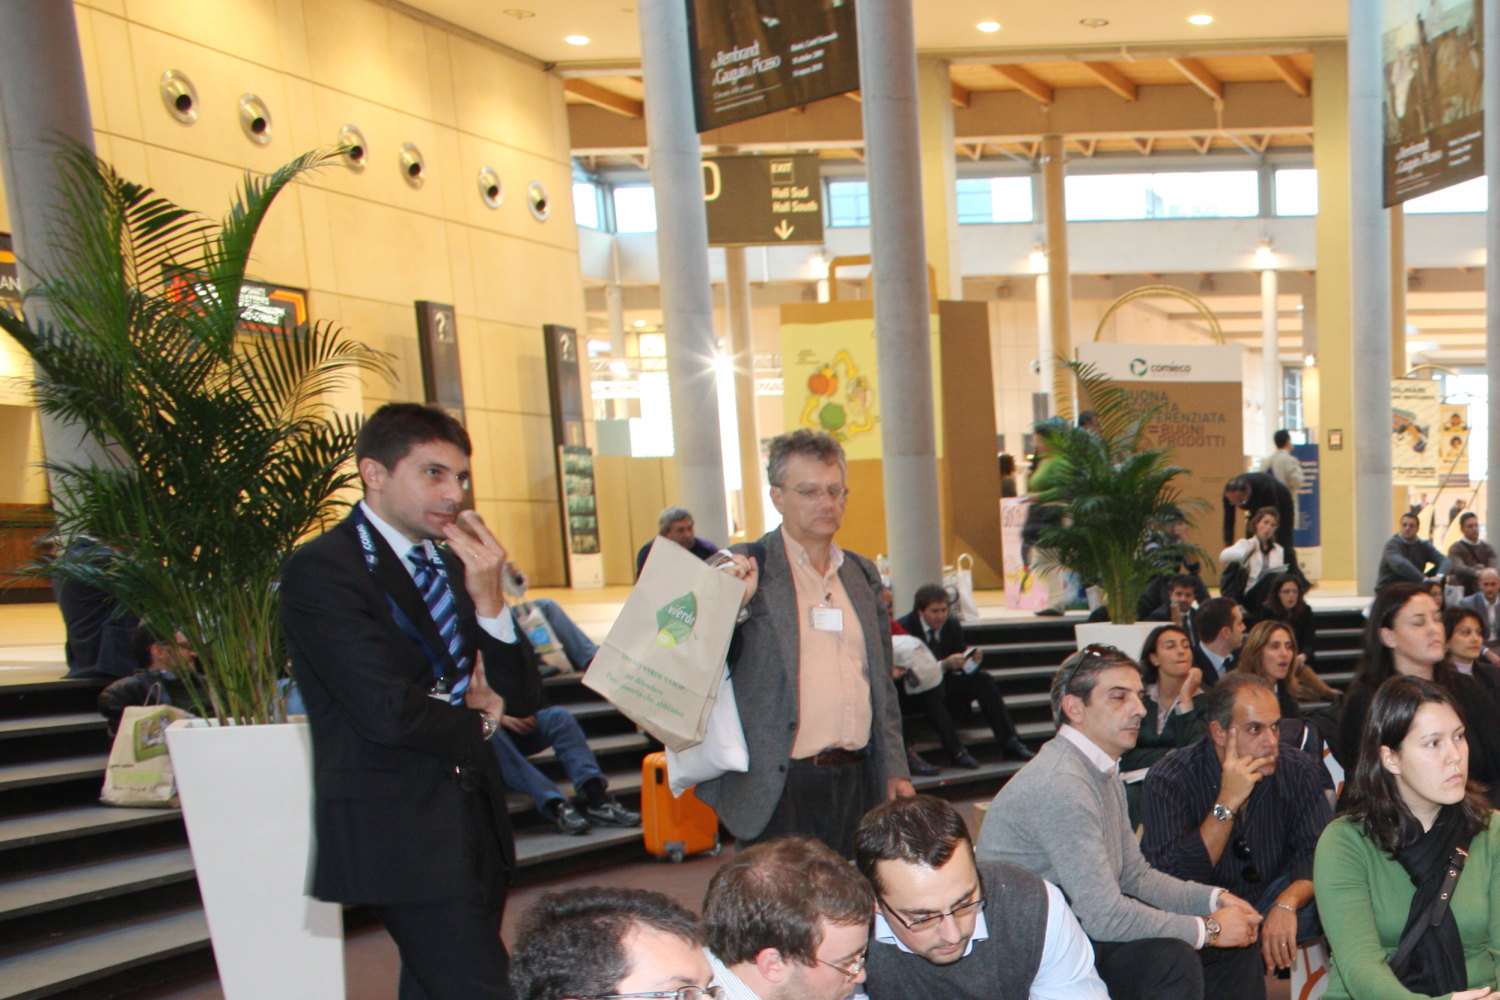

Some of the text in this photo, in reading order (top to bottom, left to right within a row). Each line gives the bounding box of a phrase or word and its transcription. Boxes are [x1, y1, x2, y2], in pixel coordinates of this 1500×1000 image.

[771, 187, 790, 199] Hall
[772, 200, 818, 213] Hall South
[1161, 423, 1205, 436] BUONI
[1158, 435, 1226, 448] PRODOTTI
